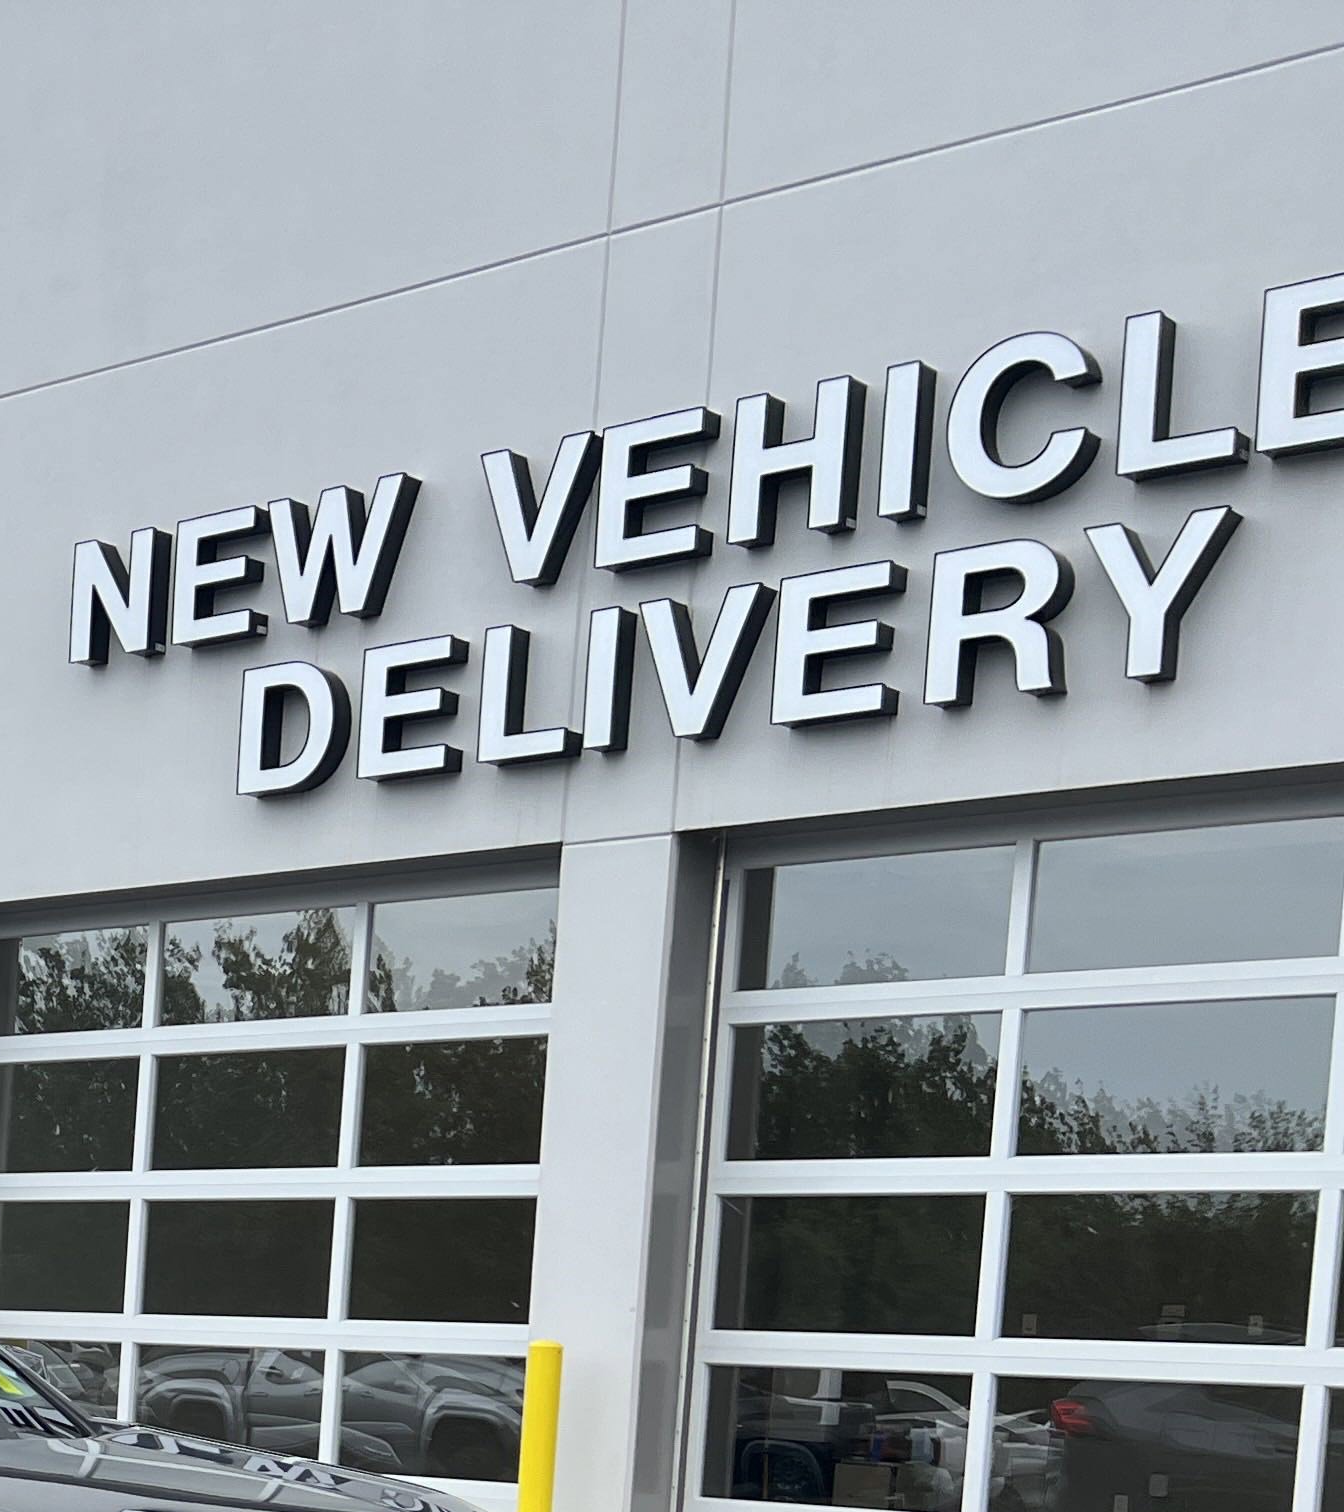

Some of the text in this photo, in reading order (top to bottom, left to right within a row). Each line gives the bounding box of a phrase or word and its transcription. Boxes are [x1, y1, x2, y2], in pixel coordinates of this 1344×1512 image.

[68, 272, 1344, 667] NEW VEHICLE
[236, 505, 1244, 799] DELIVERY
